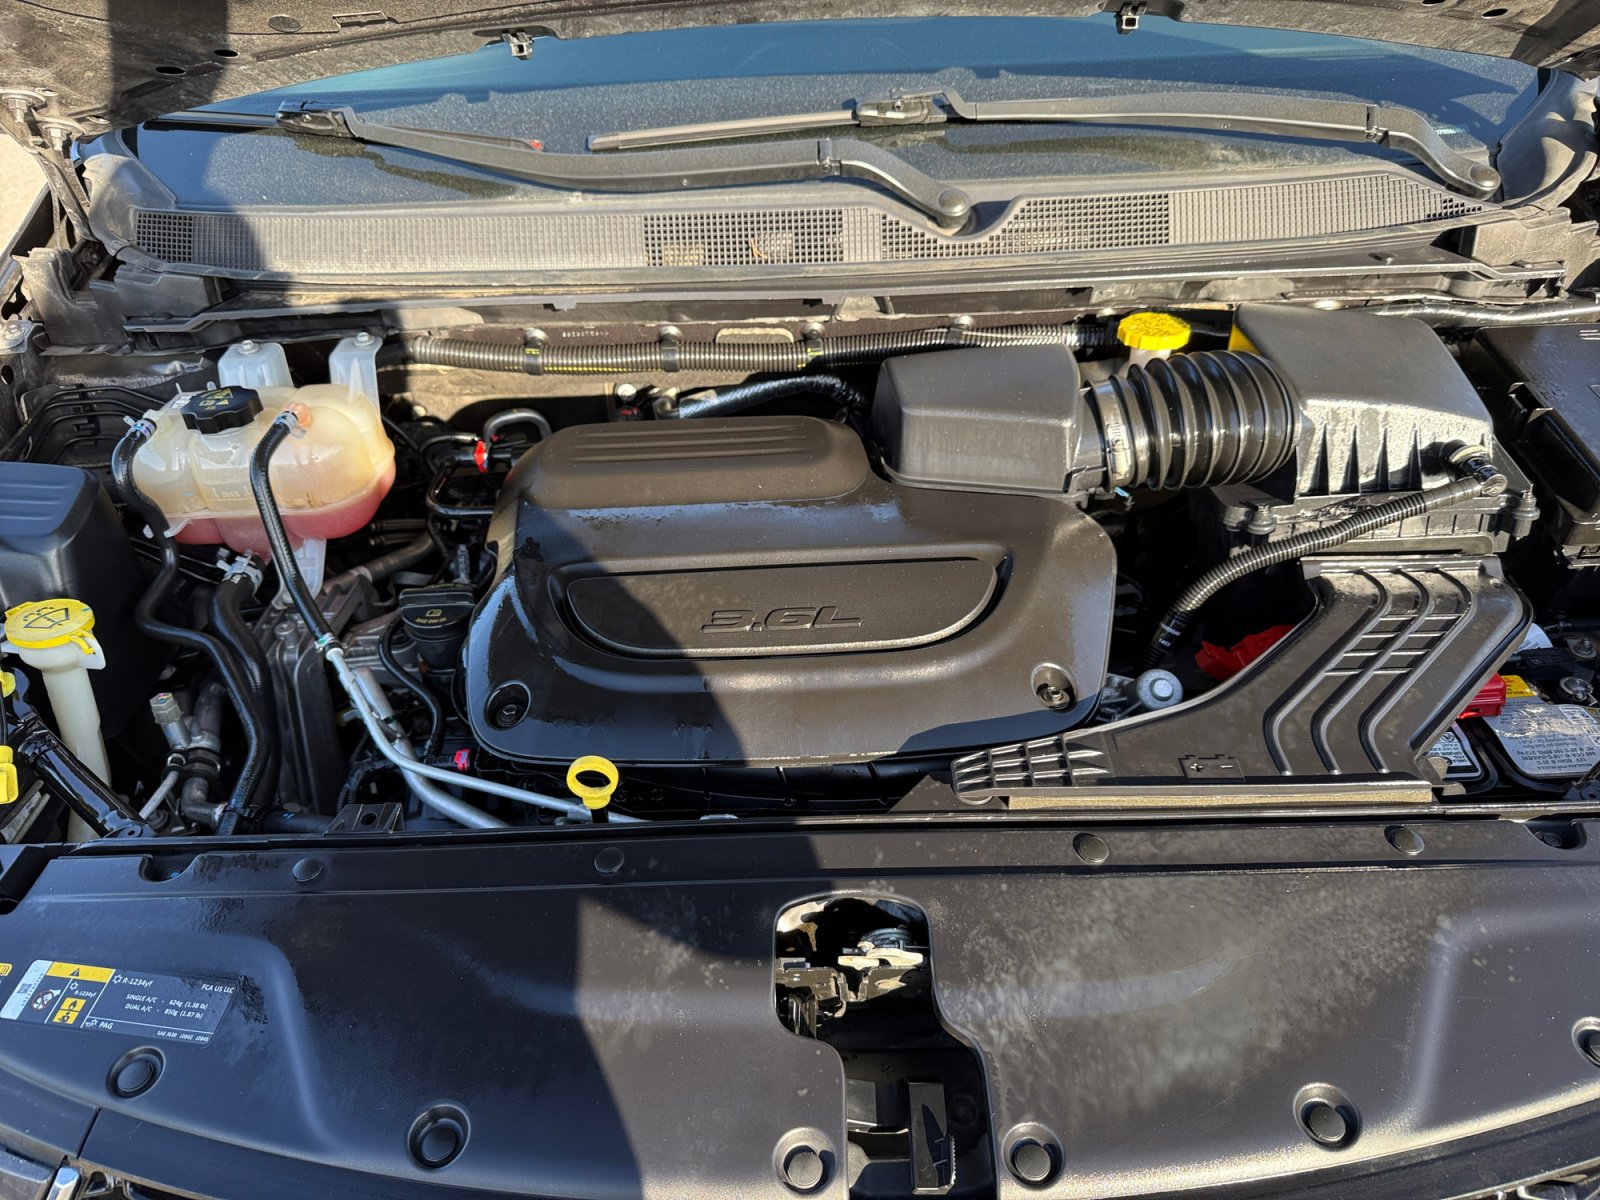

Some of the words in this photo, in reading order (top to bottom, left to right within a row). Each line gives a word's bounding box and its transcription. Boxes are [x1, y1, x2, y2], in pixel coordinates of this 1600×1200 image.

[700, 605, 863, 633] 3.6L
[122, 975, 154, 988] R-1234yf
[201, 984, 214, 992] FCA
[126, 994, 146, 1002] SINGLE
[146, 996, 158, 1004] A/C
[98, 1020, 114, 1030] PAG
